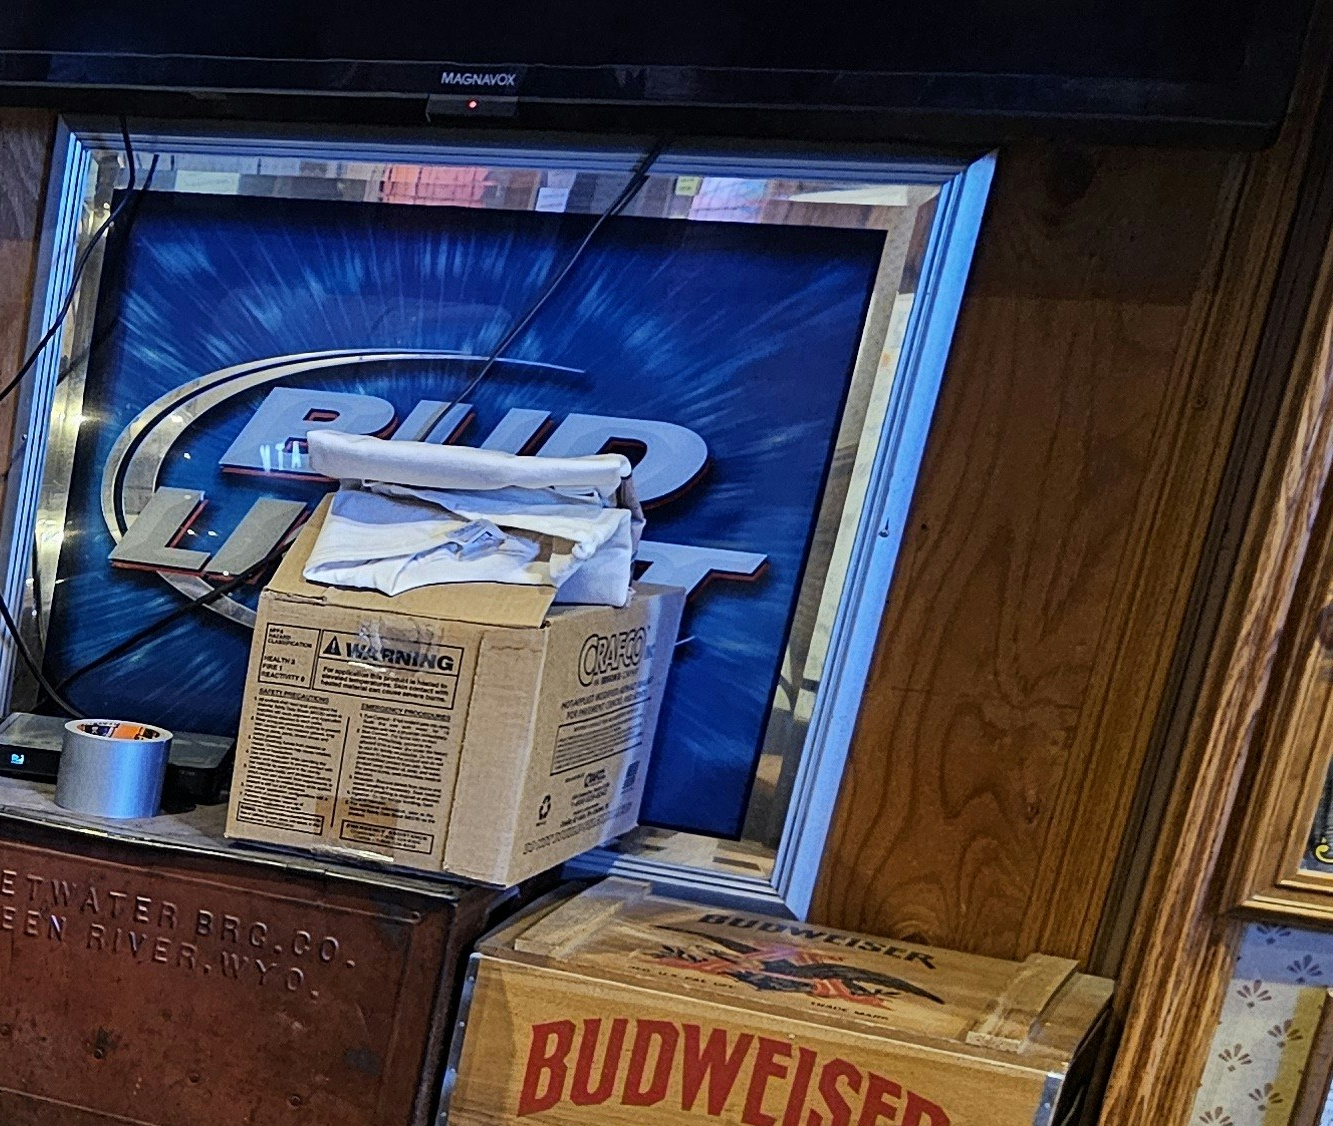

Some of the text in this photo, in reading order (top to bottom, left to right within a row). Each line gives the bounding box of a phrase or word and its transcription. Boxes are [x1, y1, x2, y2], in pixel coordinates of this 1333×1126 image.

[440, 71, 517, 86] MAGNAVOX
[108, 485, 768, 598] LIT
[345, 642, 454, 672] WARNING
[577, 626, 646, 688] CRAFCO
[697, 913, 938, 970] BUDWEISER
